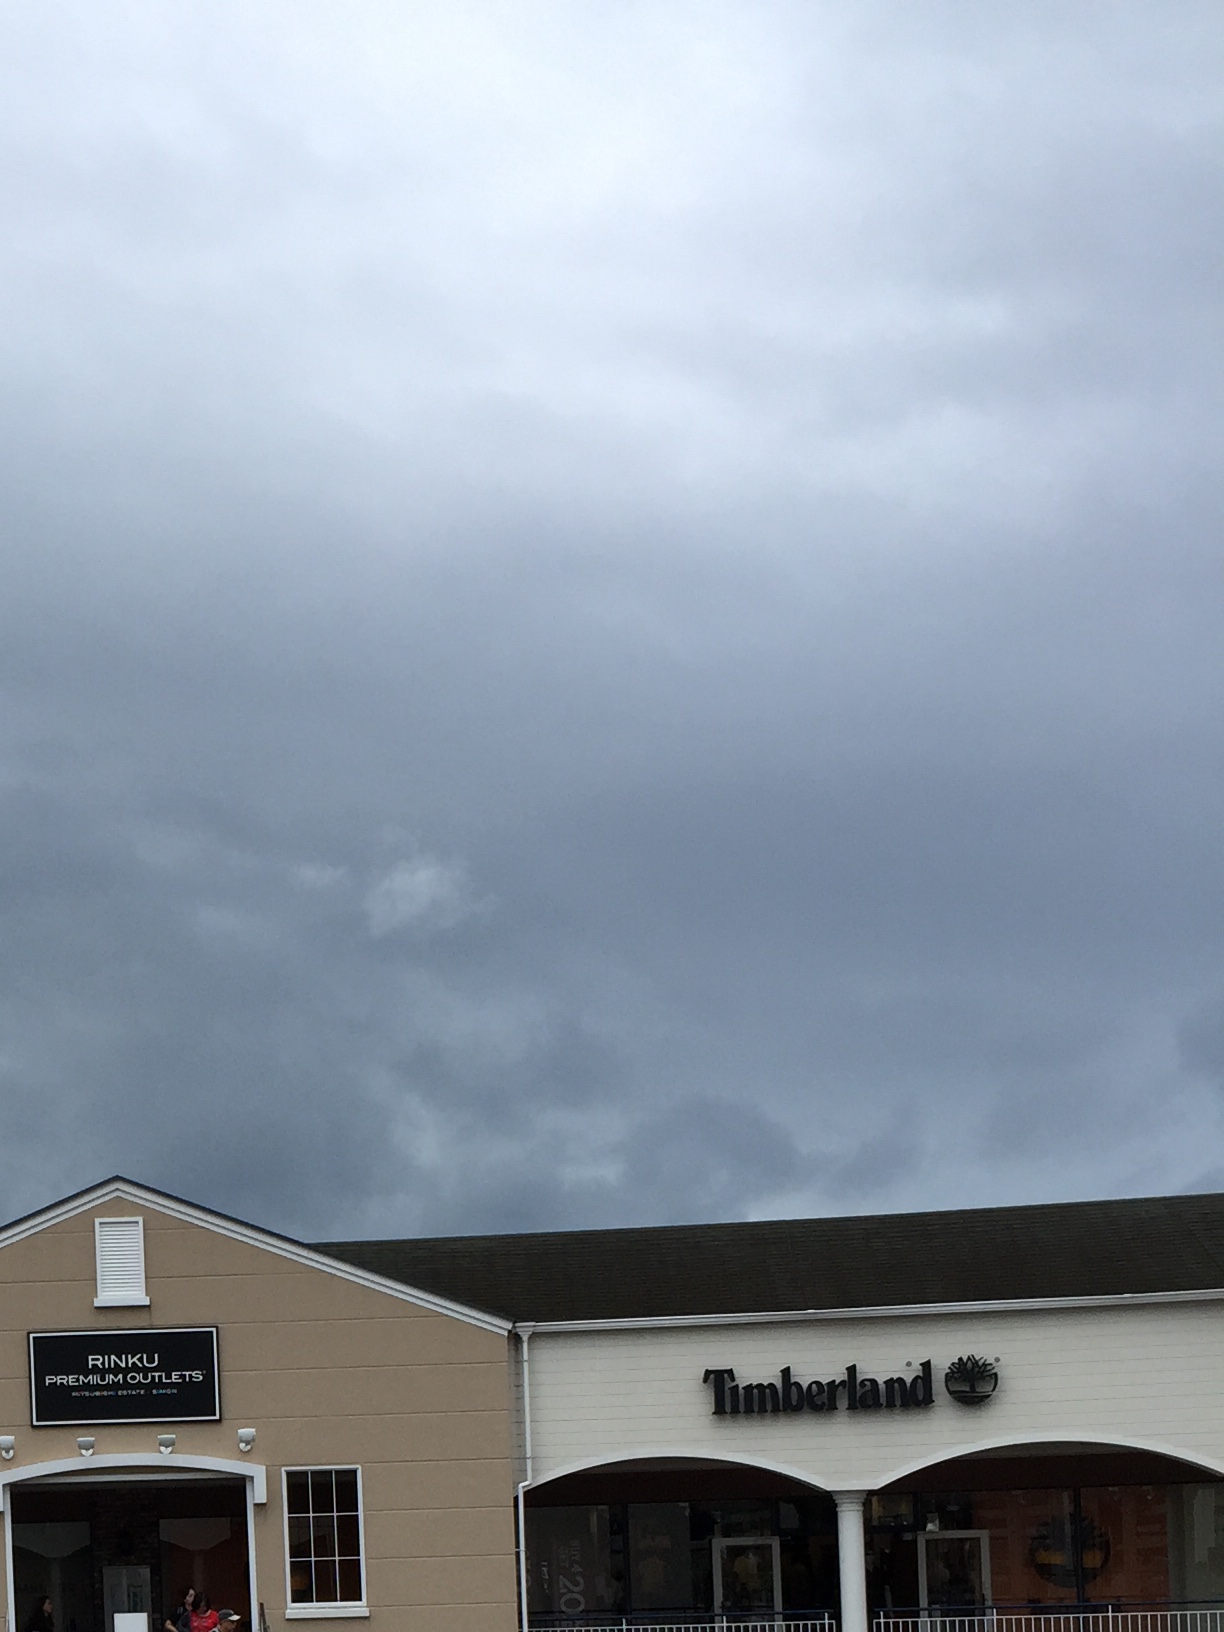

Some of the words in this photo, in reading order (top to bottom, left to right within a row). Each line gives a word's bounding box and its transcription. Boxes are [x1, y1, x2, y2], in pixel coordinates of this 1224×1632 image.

[87, 1353, 159, 1369] RINKU
[45, 1373, 123, 1386] PREMIUM
[126, 1370, 204, 1384] OUTLETS
[117, 1388, 146, 1396] ESTATE
[152, 1388, 178, 1396] SIMON
[702, 1358, 936, 1415] Timberland
[558, 1574, 586, 1615] 20
